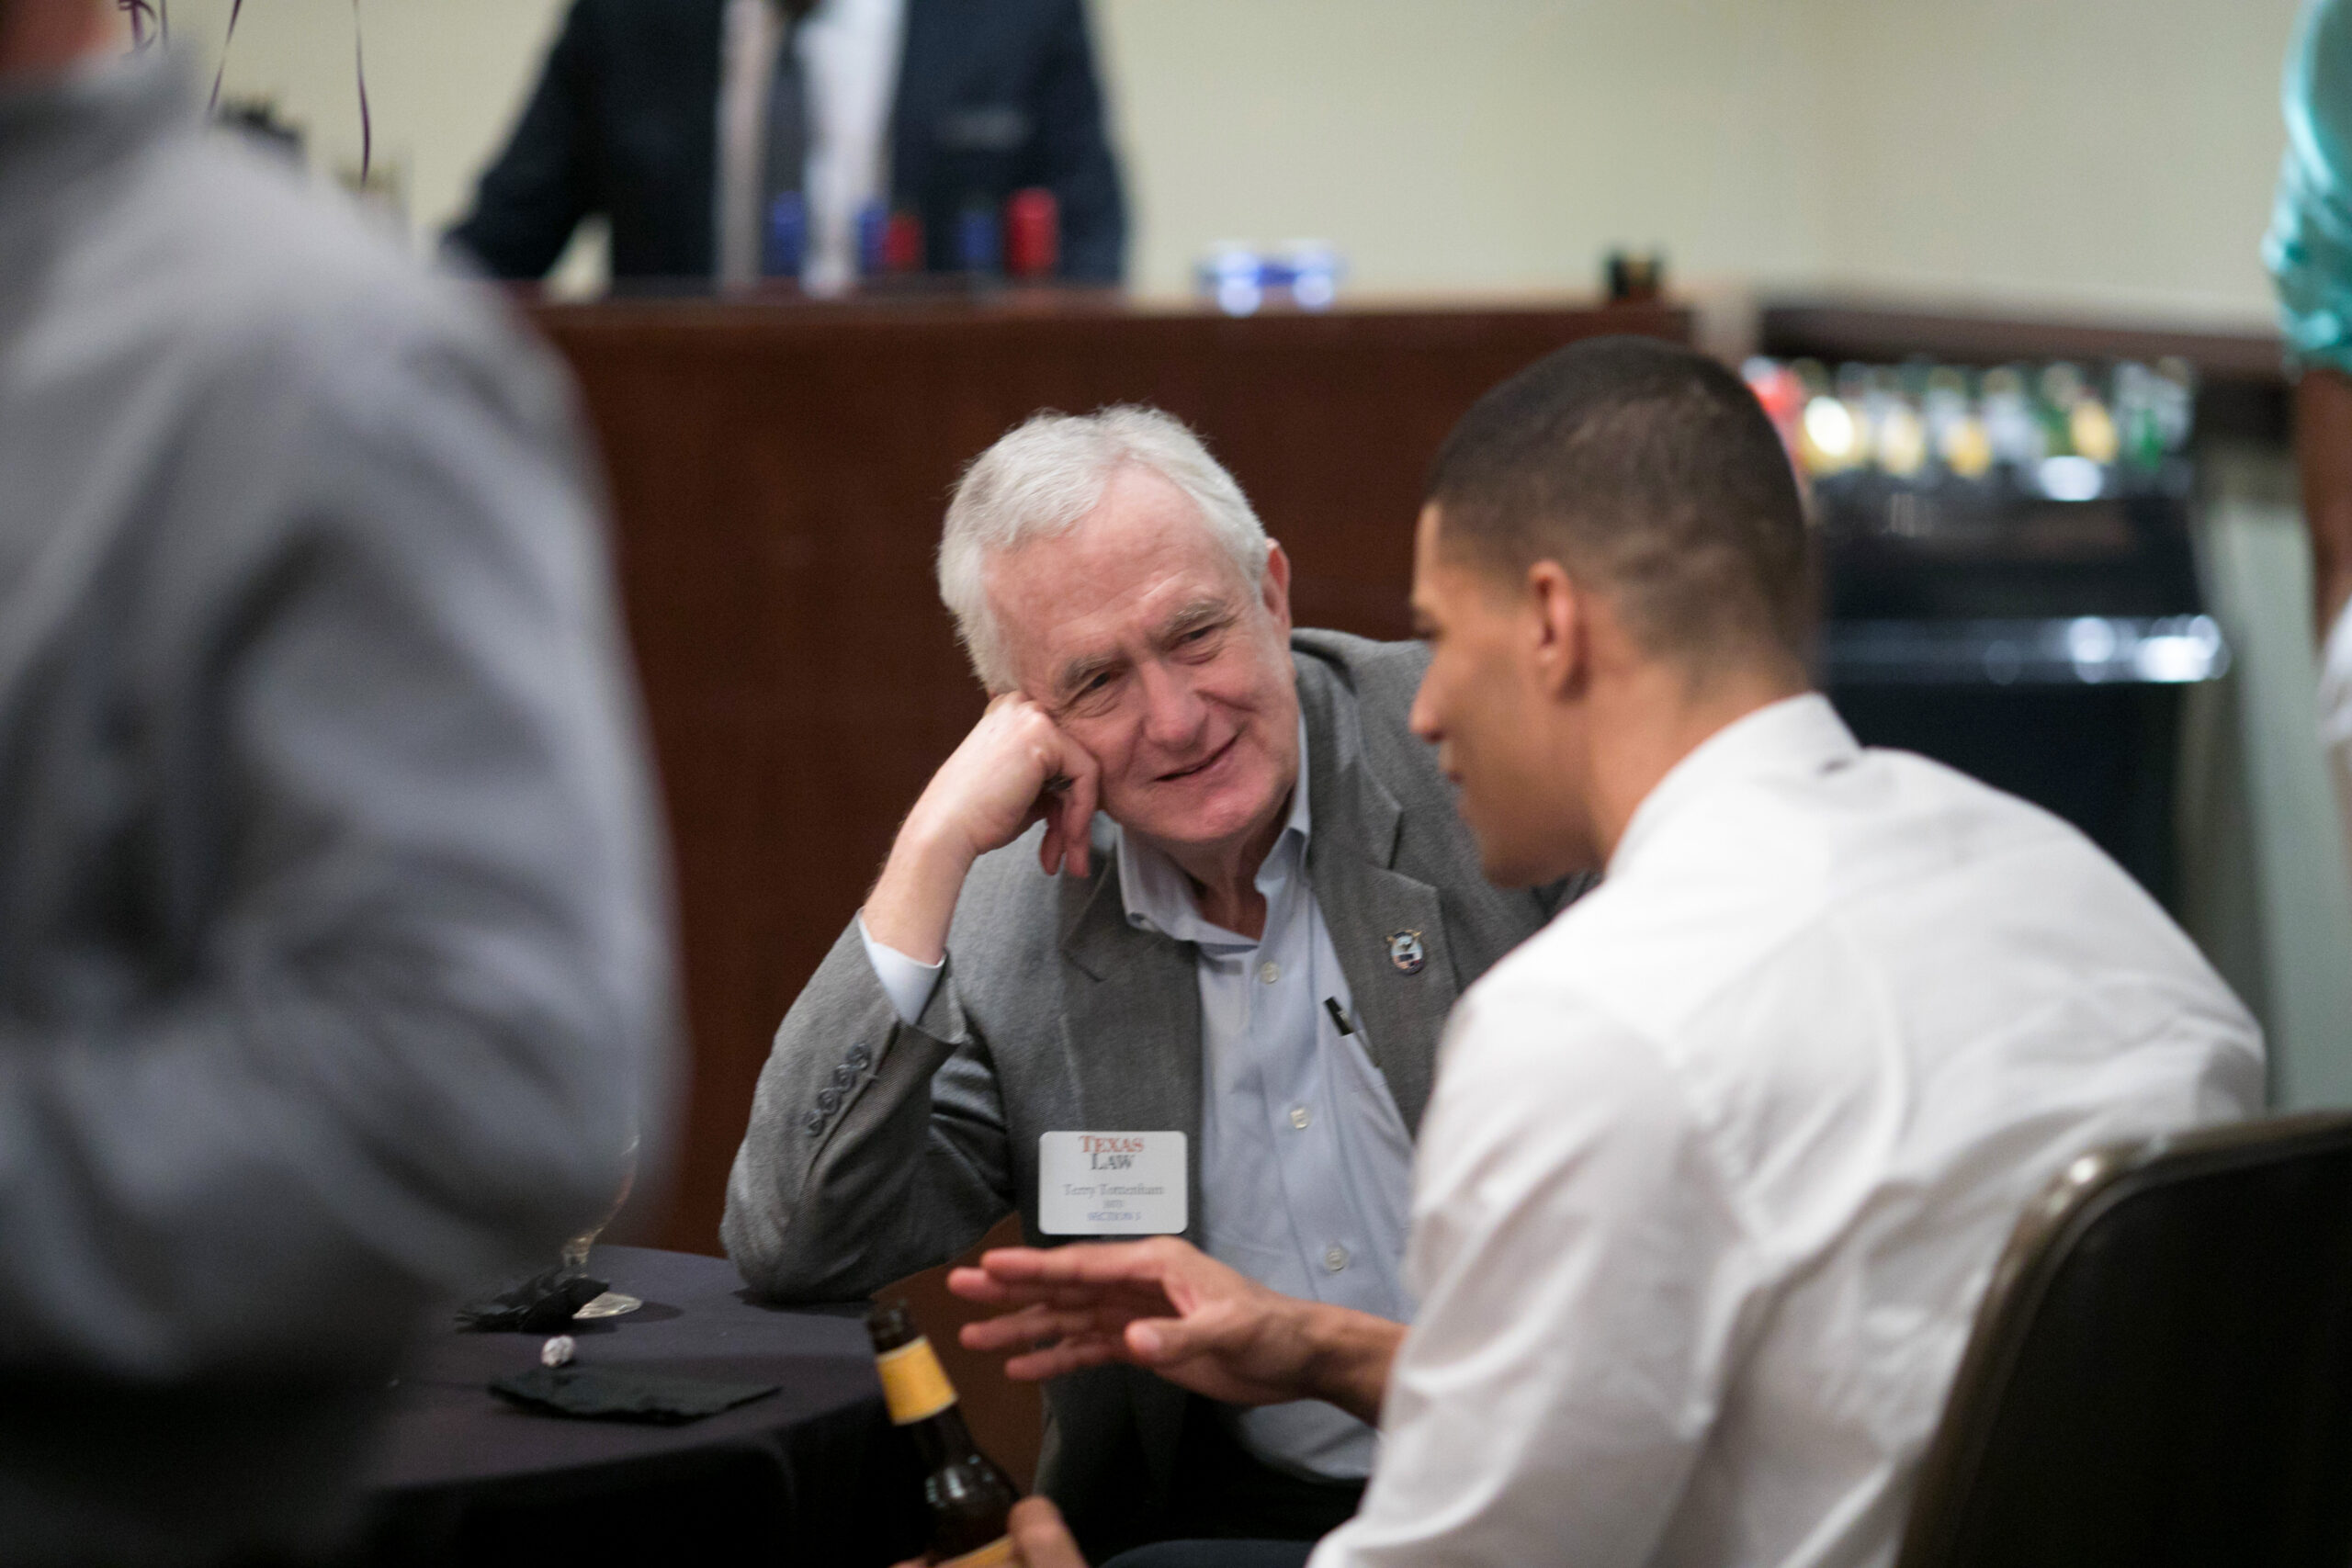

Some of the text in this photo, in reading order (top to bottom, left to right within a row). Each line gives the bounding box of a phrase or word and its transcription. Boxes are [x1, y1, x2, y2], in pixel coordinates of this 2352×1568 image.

[1079, 1135, 1145, 1153] TEXAS
[1091, 1153, 1136, 1170] LAW
[1063, 1184, 1096, 1199] Terry
